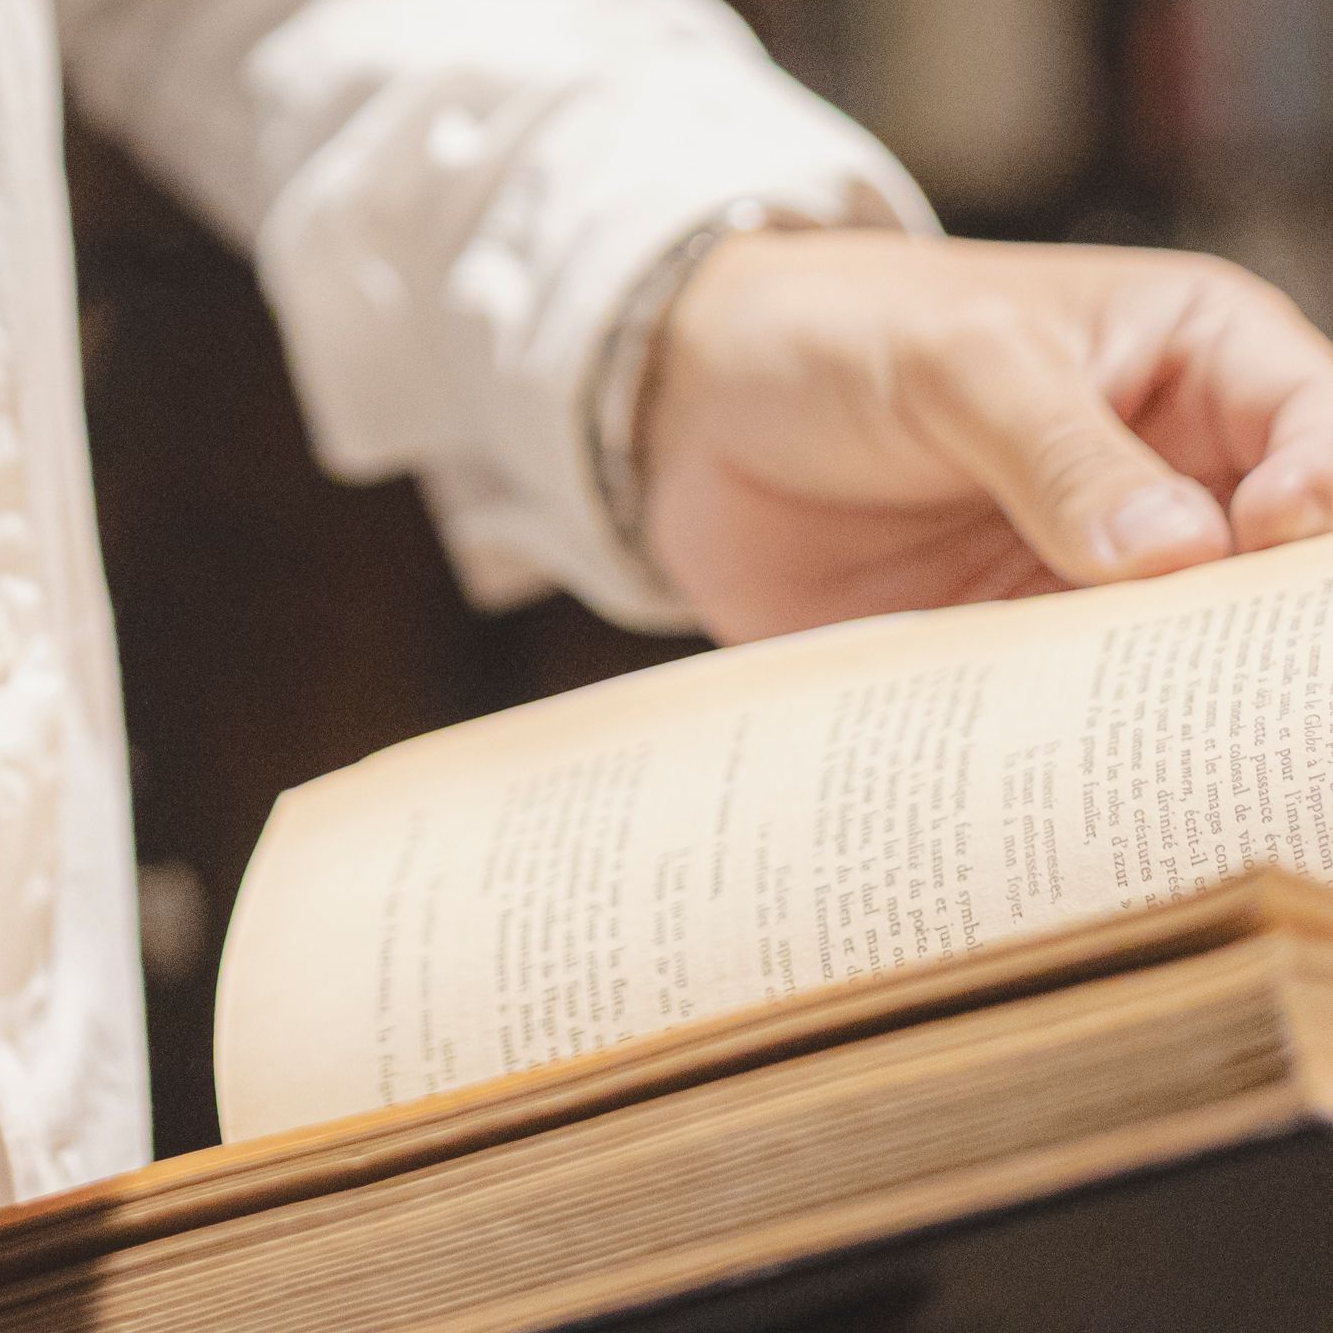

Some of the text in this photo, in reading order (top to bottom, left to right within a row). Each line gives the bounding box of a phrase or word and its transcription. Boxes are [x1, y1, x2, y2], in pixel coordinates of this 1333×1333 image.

[1204, 738, 1216, 751] et
[1253, 715, 1266, 746] cette
[1279, 727, 1292, 740] et
[1304, 714, 1322, 752] Globe
[1077, 735, 1096, 776] groupe
[1155, 759, 1167, 784] une
[1204, 755, 1222, 775] les
[1229, 743, 1251, 797] colossal
[1275, 748, 1294, 781] pour
[1307, 758, 1323, 768] à
[1106, 763, 1124, 782] les
[1131, 778, 1149, 800] des
[1179, 749, 1194, 803] numen,
[1249, 753, 1273, 823] puissance
[931, 816, 948, 831] la
[1002, 818, 1020, 826] à
[1081, 782, 1101, 846] familier,
[1107, 789, 1125, 827] robes
[1156, 789, 1178, 850] divinité
[1204, 781, 1224, 835] images
[1234, 804, 1252, 822] de
[1306, 772, 1333, 870] l'apparition
[883, 838, 901, 861] lui
[954, 822, 972, 856] faite
[1002, 835, 1018, 868] mon
[1133, 809, 1154, 882] créatures
[1184, 809, 1208, 867] écrit-il
[1264, 833, 1281, 866] évo
[860, 857, 878, 872] le
[930, 838, 945, 889] nature
[1022, 814, 1042, 897] embrassées
[1041, 818, 1065, 905] empressées,
[1111, 836, 1129, 888] d'azur
[836, 865, 854, 885] du
[884, 866, 902, 888] les
[908, 878, 926, 900] du
[956, 864, 973, 882] de
[837, 891, 854, 928] bien
[860, 882, 880, 917] duel
[935, 897, 948, 915] et
[1005, 875, 1024, 925] foyer.
[1120, 898, 1132, 909] »
[813, 883, 834, 981] Exterminez
[885, 896, 902, 938] mots
[758, 936, 773, 977] roses
[841, 937, 857, 955] et
[654, 956, 671, 976] de
[671, 951, 688, 990] coup
[678, 999, 695, 1018] de
